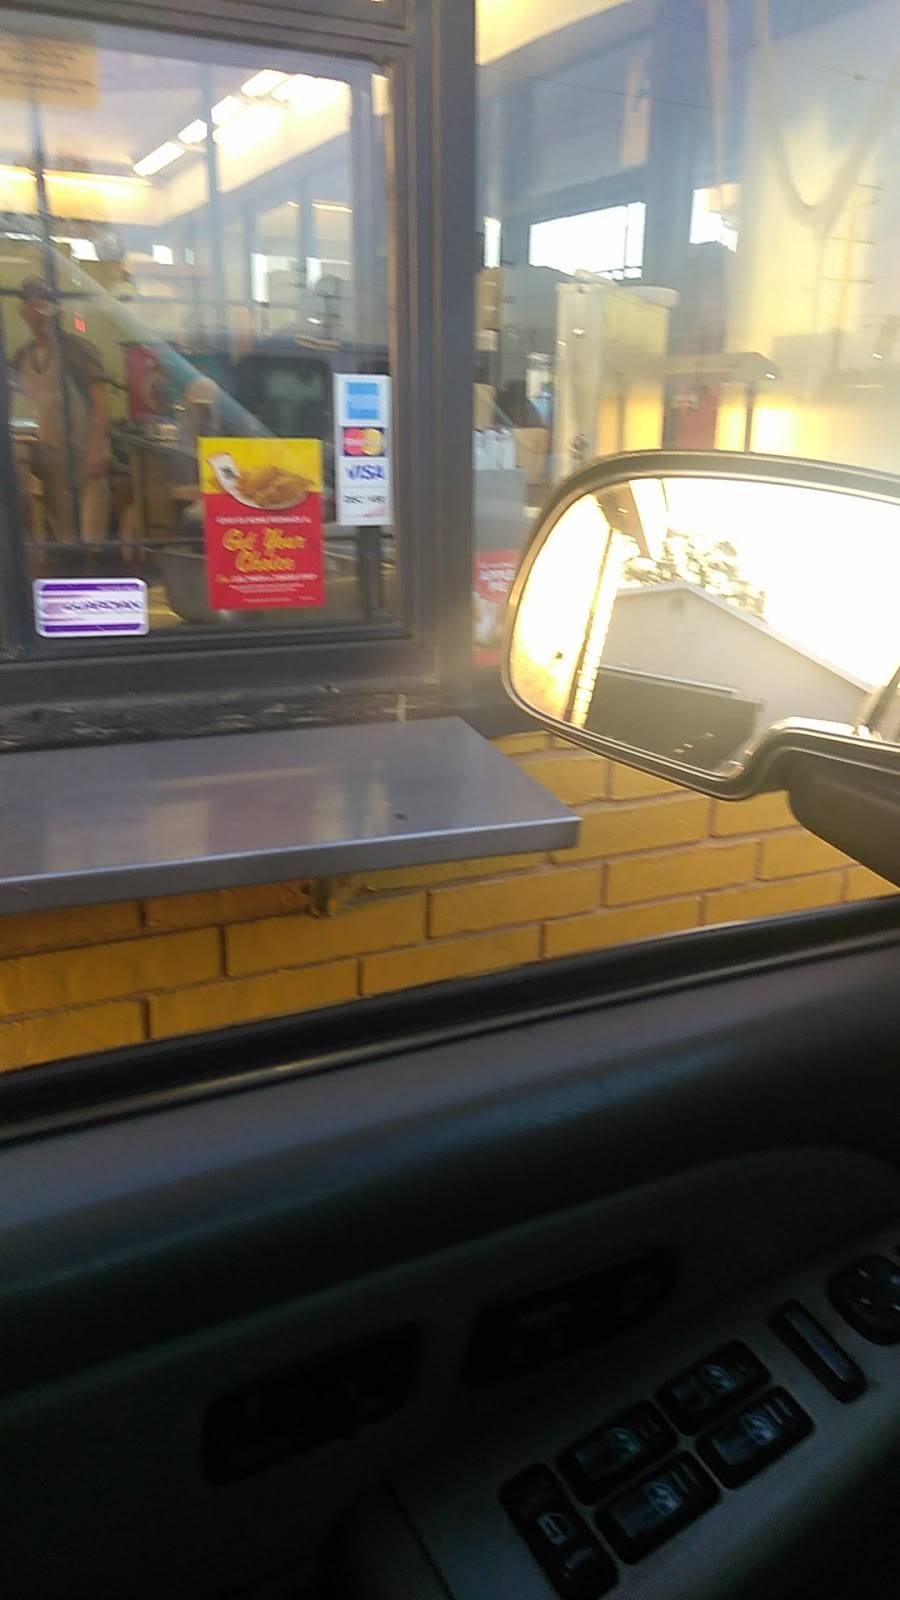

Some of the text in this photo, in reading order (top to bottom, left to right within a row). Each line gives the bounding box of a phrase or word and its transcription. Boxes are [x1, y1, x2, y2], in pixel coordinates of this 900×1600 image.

[345, 464, 384, 480] VISA
[222, 527, 306, 556] Get Your
[235, 549, 295, 573] Choice
